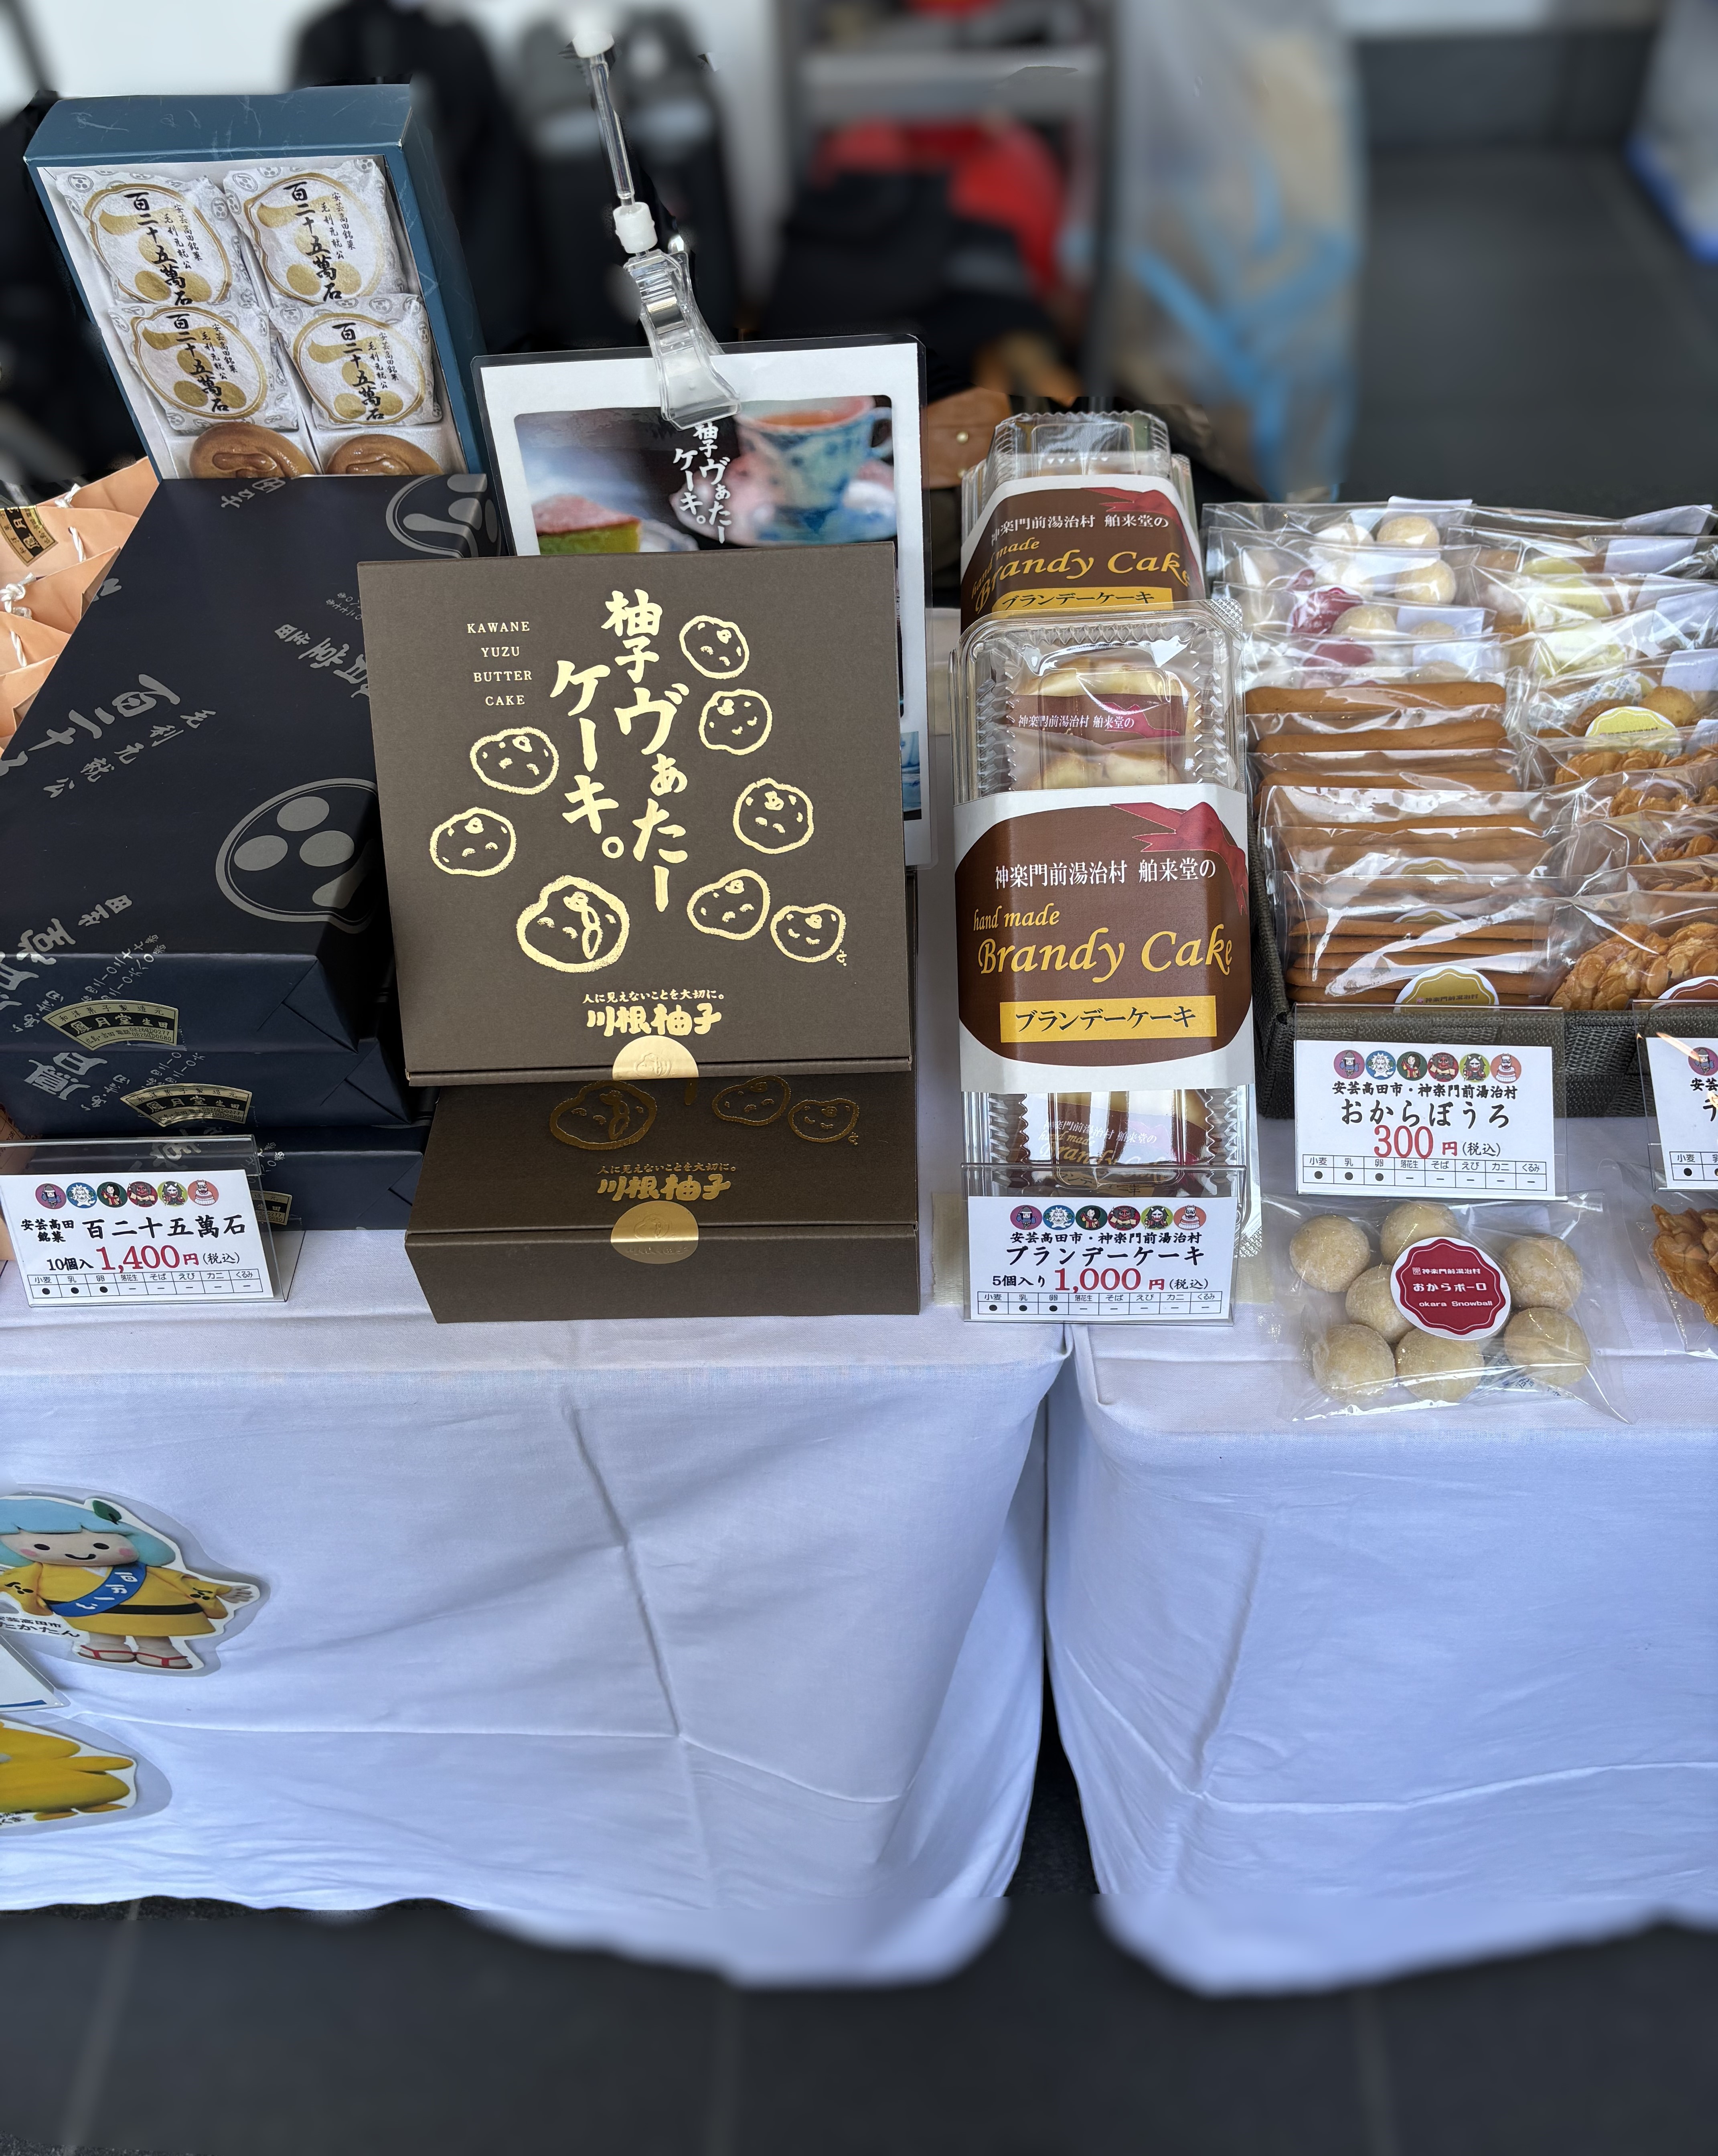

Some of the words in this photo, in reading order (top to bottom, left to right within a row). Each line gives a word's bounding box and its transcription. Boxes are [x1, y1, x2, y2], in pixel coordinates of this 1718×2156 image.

[972, 551, 996, 597] hand
[996, 537, 1040, 558] made
[975, 549, 1094, 615] Brandy
[1107, 551, 1190, 587] Cake
[1002, 591, 1155, 610] ブランデーケーキ
[467, 621, 530, 634] KAWANE
[481, 646, 521, 658] YUZU
[474, 669, 533, 683] BUTTER
[485, 694, 525, 707] CAKE
[550, 660, 624, 860] ケーキ。
[995, 860, 1127, 890] 神楽門前湯治村
[1138, 858, 1216, 882] 舶来堂の
[973, 905, 1000, 931] hand
[1004, 903, 1060, 927] made
[978, 927, 1125, 983] Brandy
[1141, 923, 1233, 976] Cake
[582, 989, 724, 1004] 人に見えないことを大切に。
[586, 1002, 722, 1037] 川根柚子
[1015, 1006, 1196, 1032] ブランデーケーキ
[1332, 1081, 1518, 1100] 安芸高田市・神楽門前湯治村
[1341, 1098, 1509, 1129] おからぼうろ
[1374, 1125, 1457, 1159] 300円
[597, 1162, 736, 1174] 人に見えないことを大切に。
[597, 1174, 731, 1201] 川根柚子
[21, 1219, 74, 1231] 安芸高田
[82, 1214, 245, 1239] 百二十五萬石
[37, 1231, 66, 1243] 銘菓
[1010, 1231, 1202, 1244] 安芸高田市・神楽門前湯治村
[47, 1257, 94, 1271] 10個入
[96, 1245, 199, 1274] 1,400円
[1006, 1245, 1204, 1266] ブランデーケーキ
[992, 1275, 1045, 1288] 5個入り
